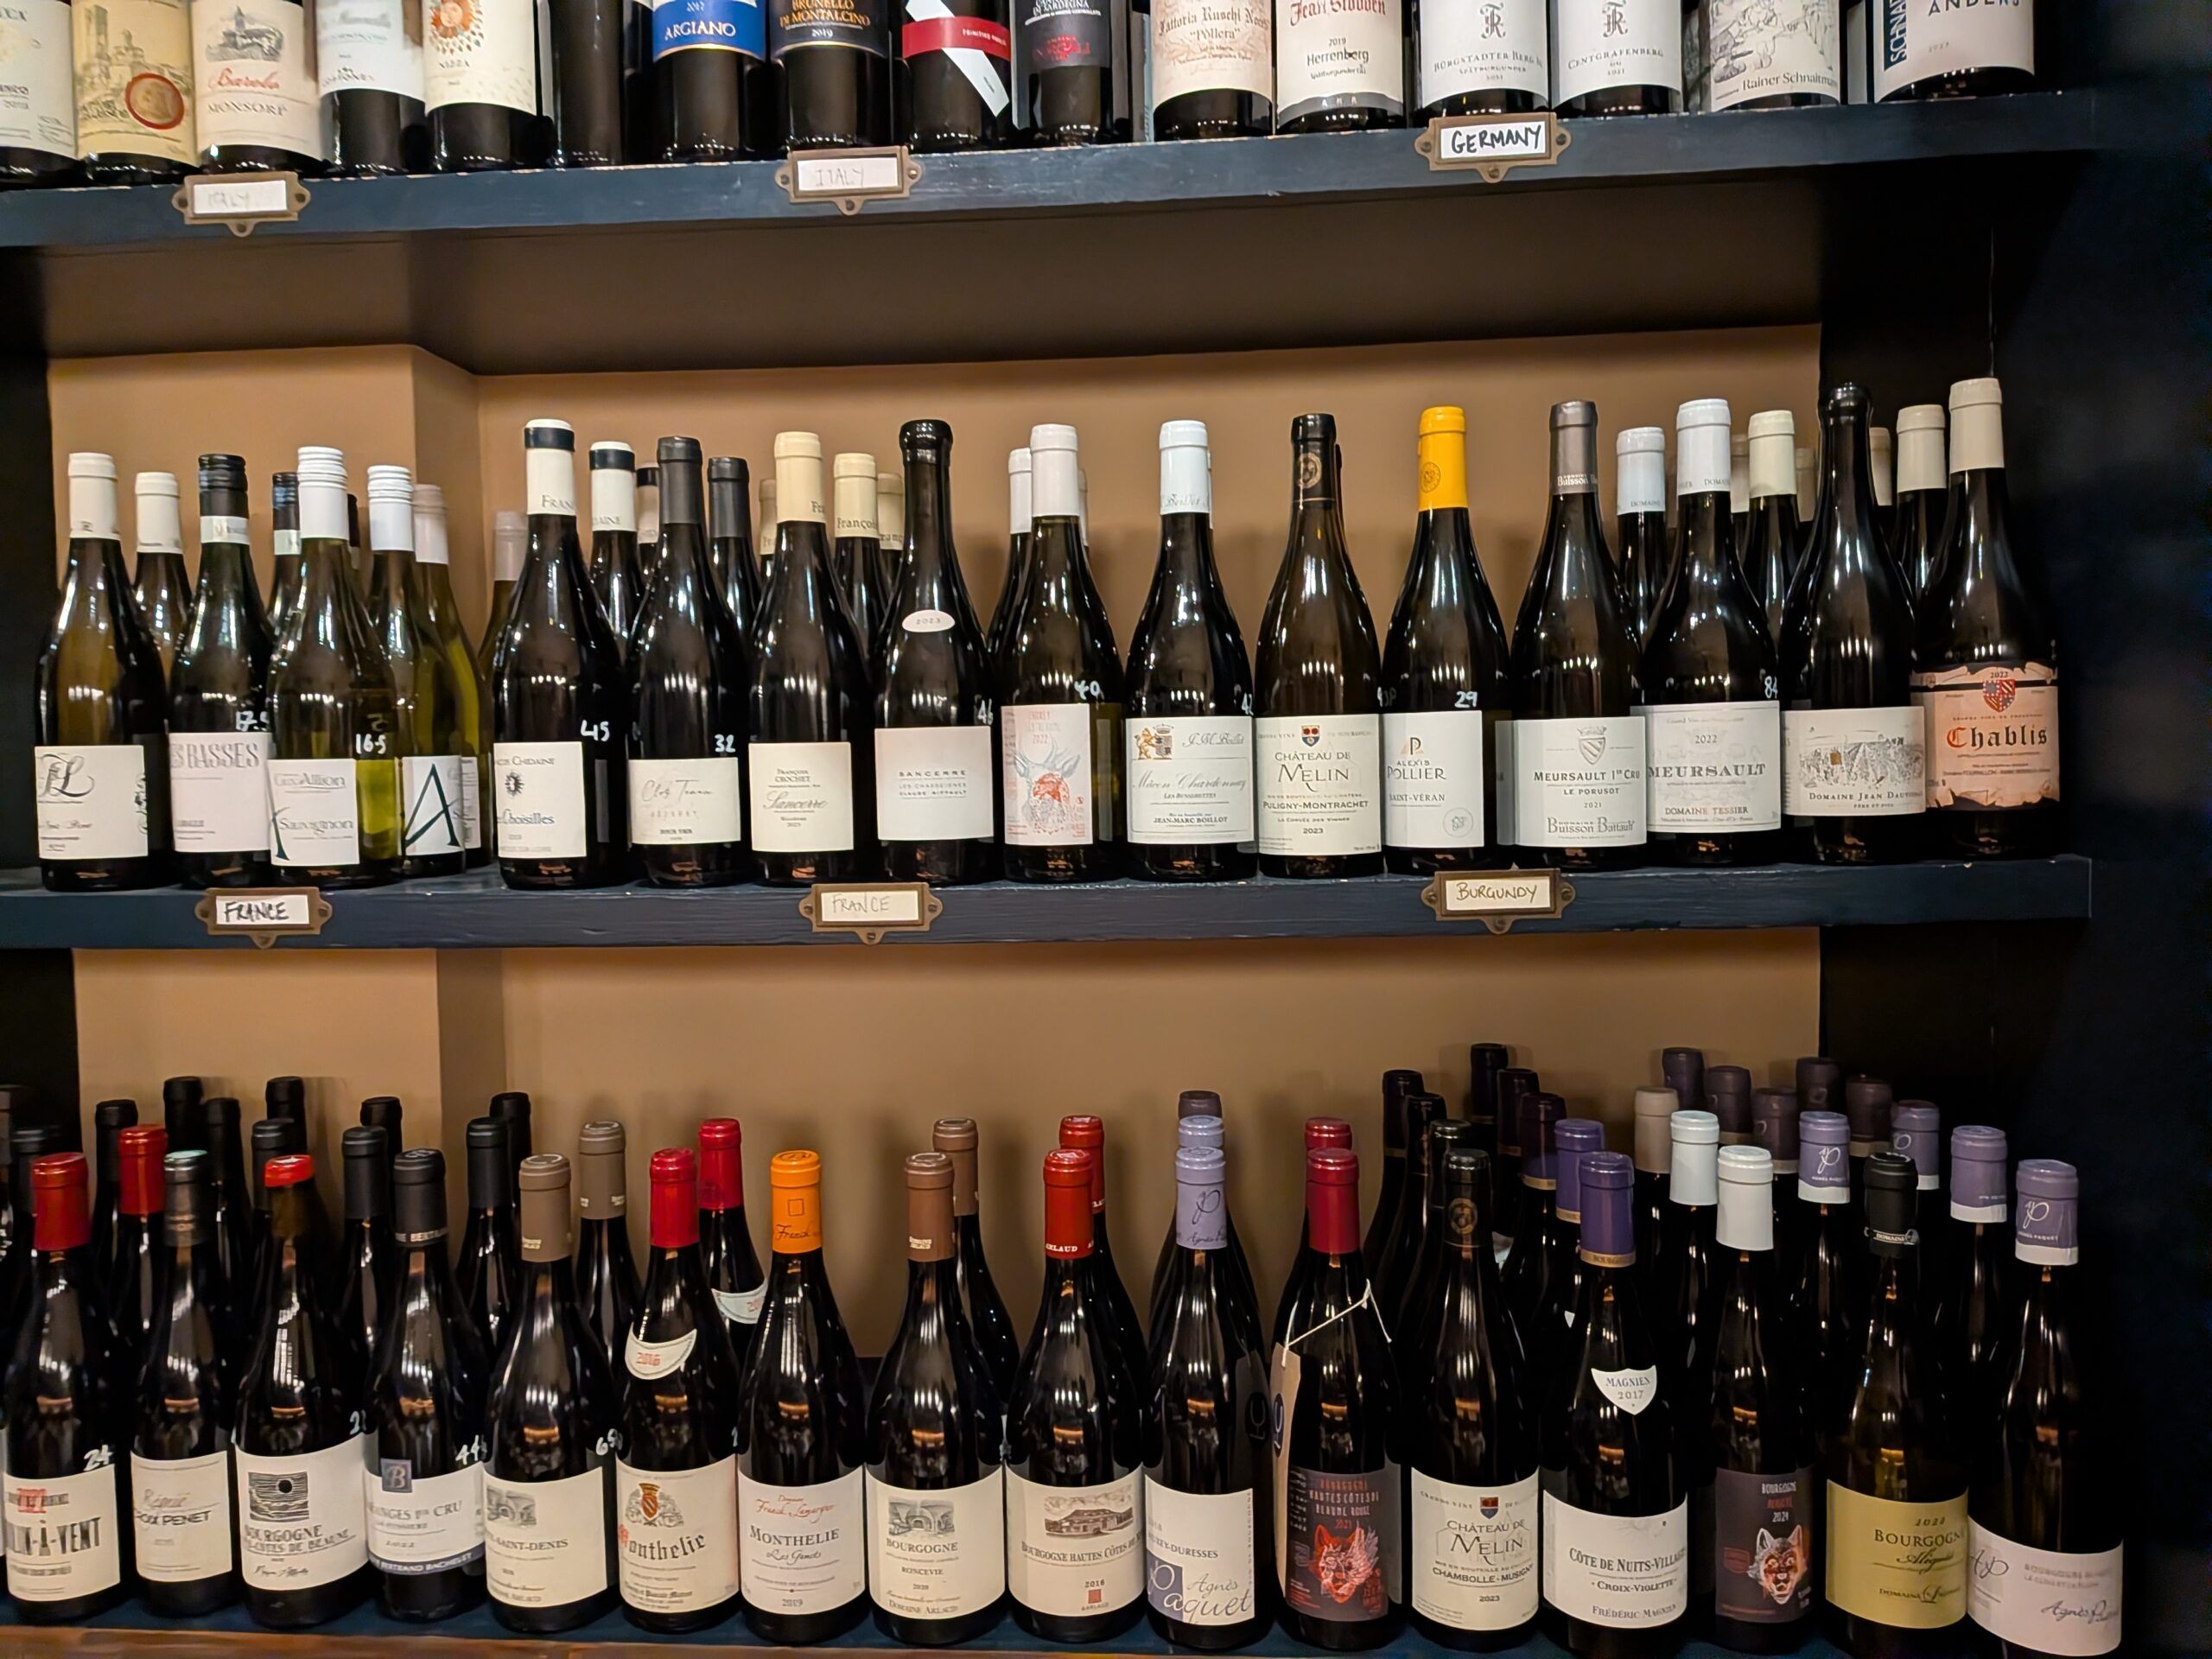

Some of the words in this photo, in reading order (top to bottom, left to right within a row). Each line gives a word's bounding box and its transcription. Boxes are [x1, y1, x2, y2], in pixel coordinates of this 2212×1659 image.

[791, 10, 871, 27] MONTALCINO
[664, 22, 736, 41] ARGIANO
[1329, 37, 1346, 47] 2019
[1306, 47, 1370, 67] Herrenberg
[1743, 73, 1781, 92] Rainer
[1452, 125, 1541, 154] GERMANY
[816, 168, 863, 188] ITALY
[1454, 691, 1478, 708] 29
[580, 720, 610, 741] 45
[1694, 734, 1718, 744] 2022
[1946, 724, 2048, 752] Chablis
[1336, 752, 1351, 760] DE
[1388, 766, 1447, 780] POLLIER
[1534, 772, 1607, 782] MEURSAULT
[1624, 769, 1640, 779] CRU
[1648, 764, 1766, 778] MEURSAULT
[763, 791, 828, 810] Sancerre
[1809, 791, 1854, 800] DOMAINE
[1858, 791, 1883, 800] JEAN
[1713, 806, 1749, 815] TESSIER
[1548, 817, 1594, 834] Buisson
[1456, 882, 1537, 904] BURGUNDY
[224, 900, 289, 923] FRANCE
[832, 893, 891, 913] FRANCE
[1618, 1390, 1644, 1400] 2017
[433, 1500, 462, 1517] CRU
[750, 1525, 841, 1547] MONTHELIE
[887, 1537, 958, 1554] BOURGOGNE
[1021, 1541, 1068, 1563] BOURGOGNE
[1569, 1547, 1598, 1568] CÔTE
[1599, 1558, 1614, 1572] DE
[1084, 1579, 1106, 1588] 2016
